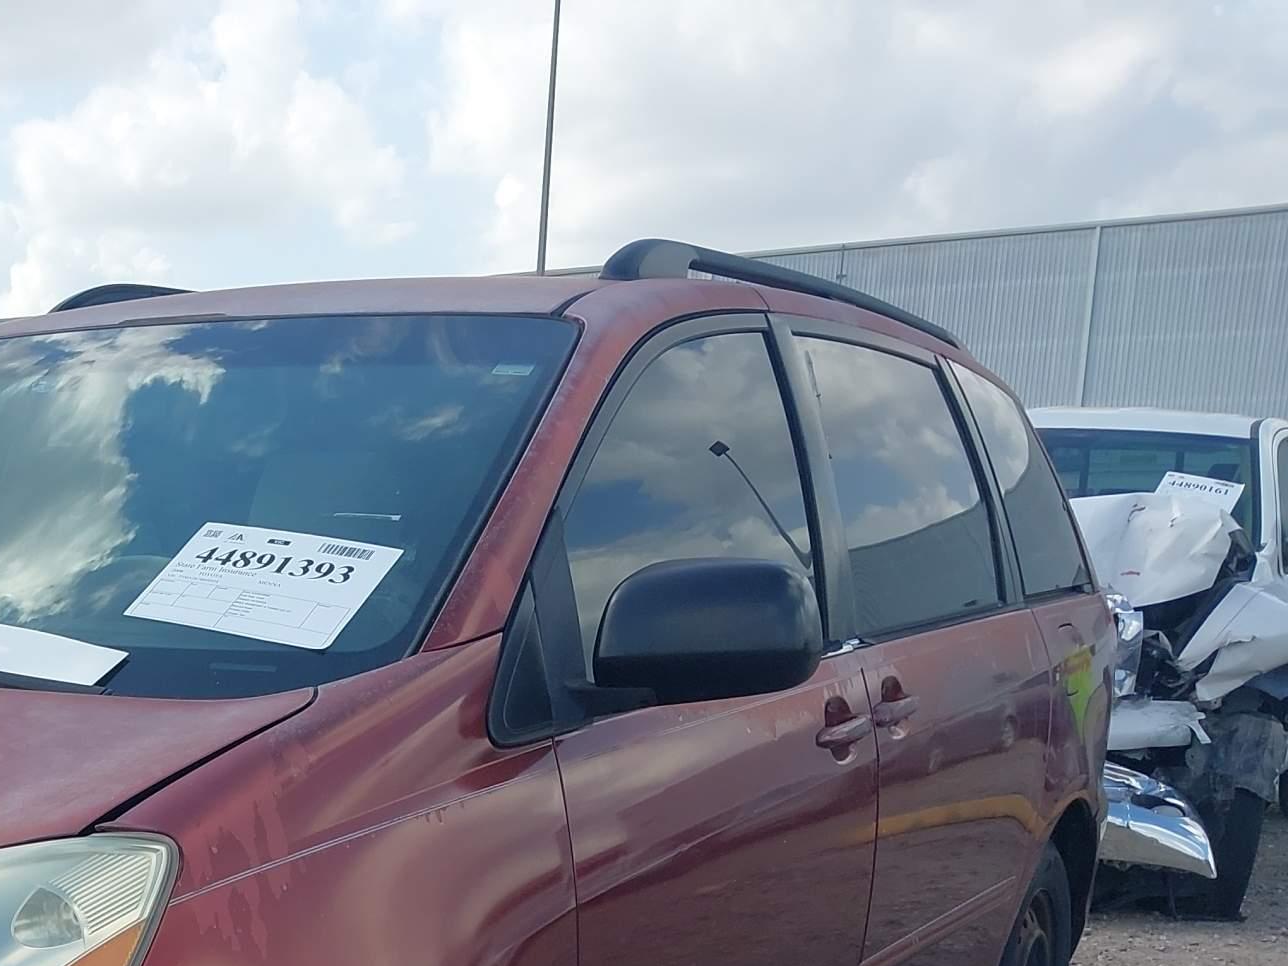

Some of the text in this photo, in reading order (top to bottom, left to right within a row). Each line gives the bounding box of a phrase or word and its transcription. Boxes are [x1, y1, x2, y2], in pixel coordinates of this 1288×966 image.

[1168, 480, 1229, 495] 44890161
[176, 562, 257, 577] State Farm Insurance
[195, 546, 355, 584] 44891393
